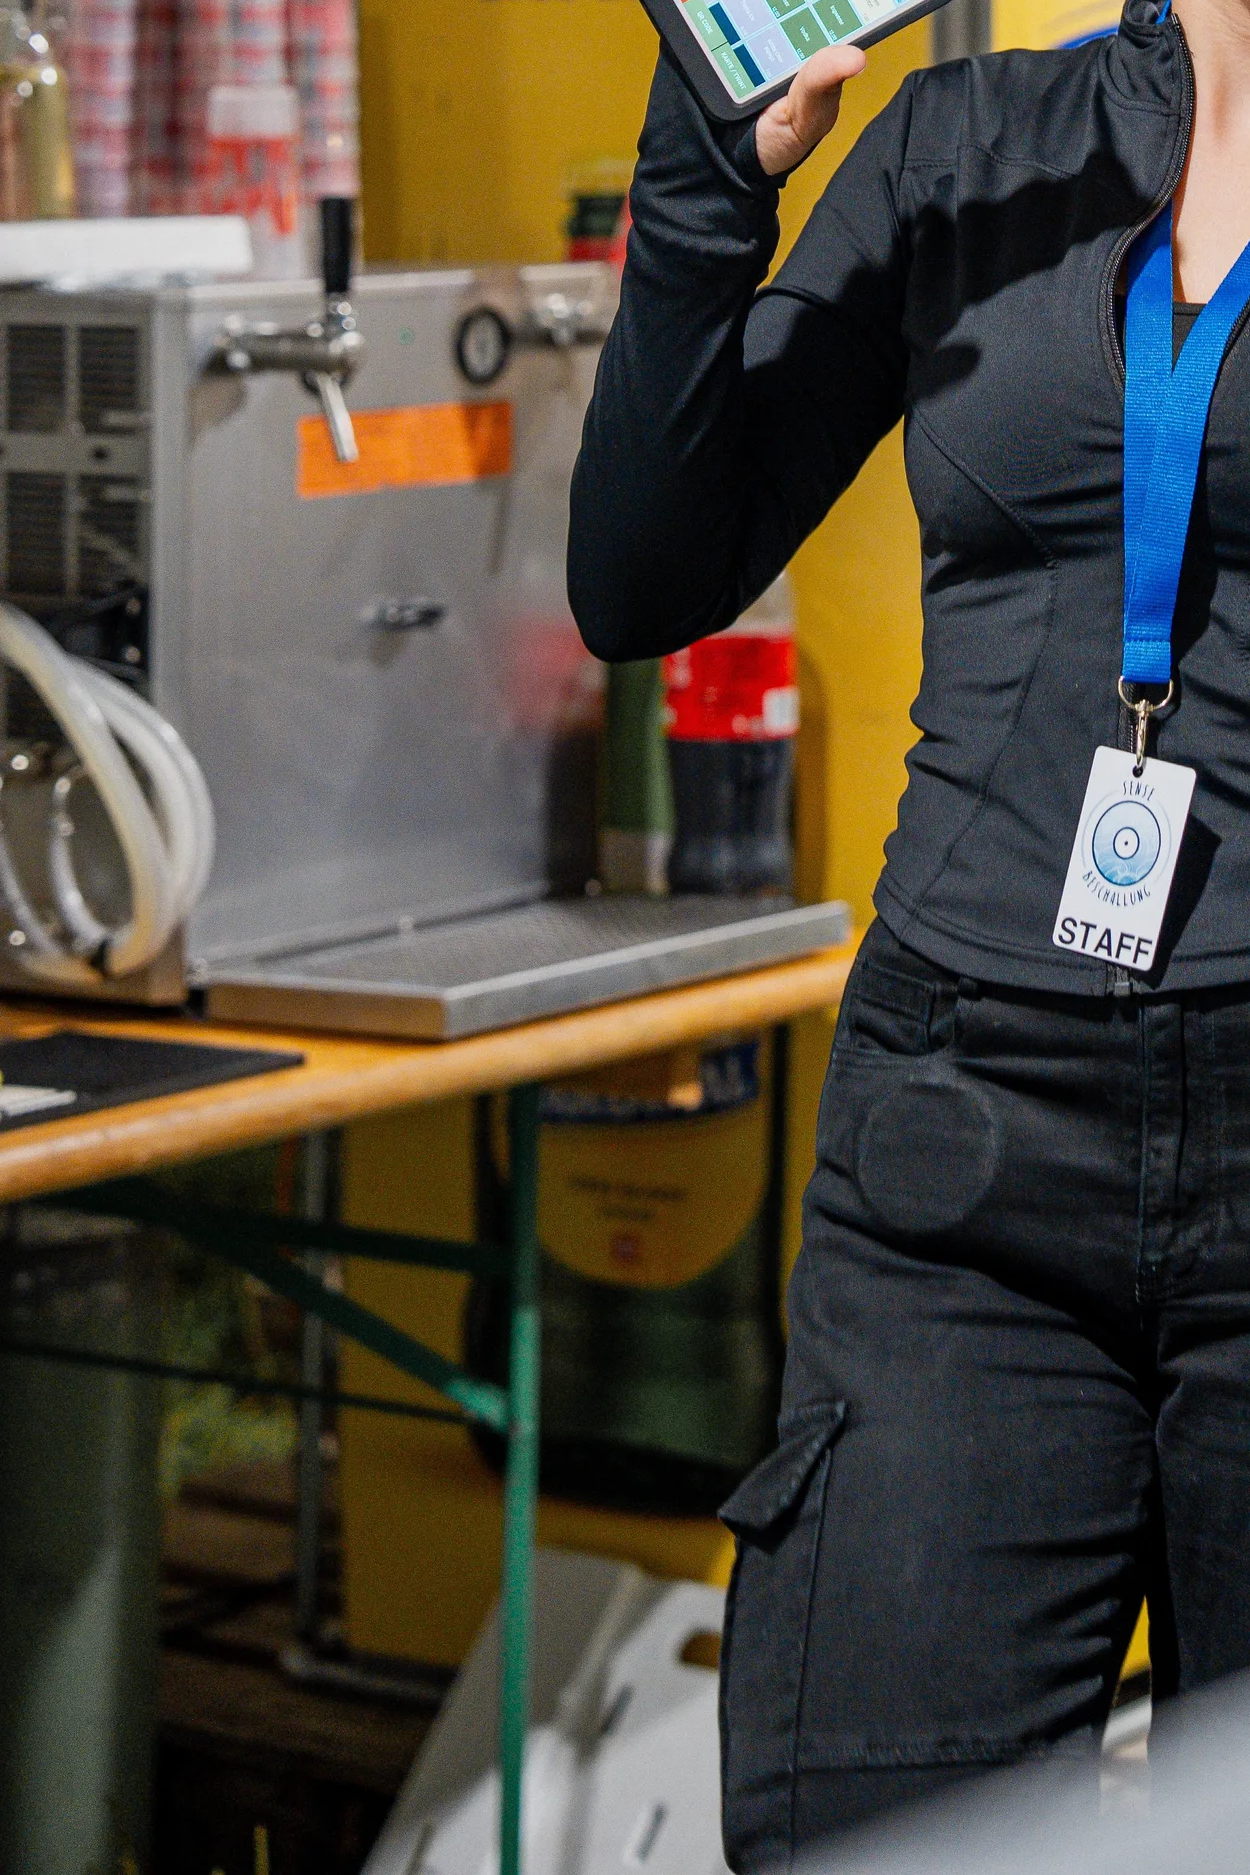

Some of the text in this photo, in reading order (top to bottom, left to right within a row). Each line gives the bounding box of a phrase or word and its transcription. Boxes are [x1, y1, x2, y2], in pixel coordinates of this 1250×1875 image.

[696, 10, 713, 34] QR CODE
[798, 25, 811, 42] Vodka
[720, 51, 733, 69] KARTE
[732, 72, 746, 90] TWINT
[1123, 781, 1156, 802] SENSE
[1082, 870, 1151, 907] BESCHALLUNG
[1058, 917, 1153, 965] STAFF
